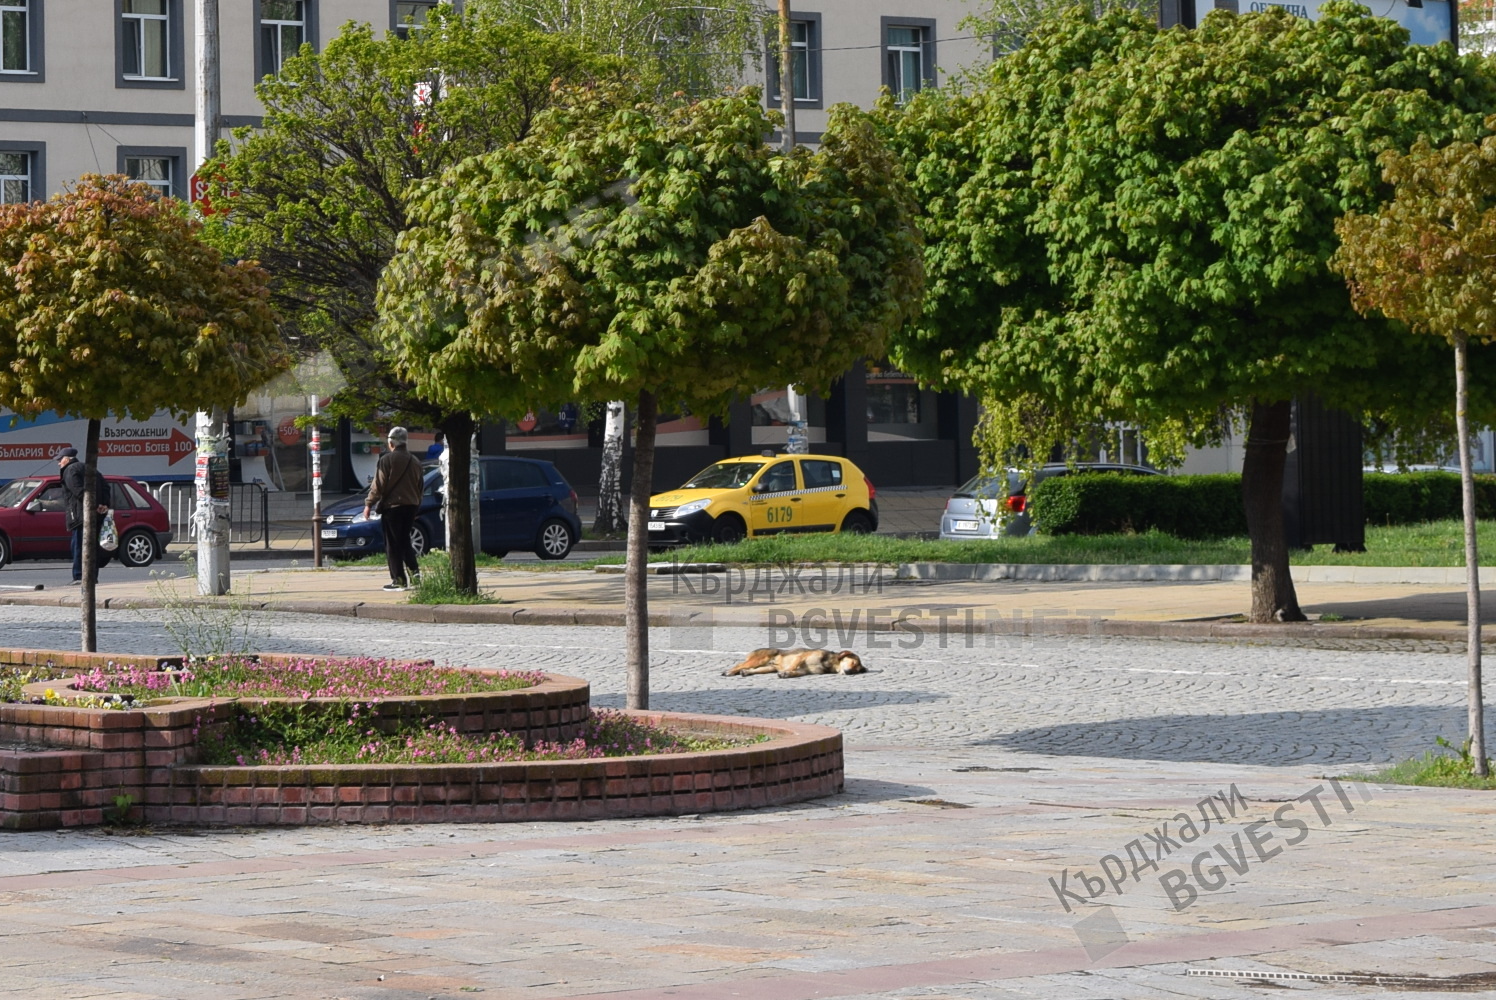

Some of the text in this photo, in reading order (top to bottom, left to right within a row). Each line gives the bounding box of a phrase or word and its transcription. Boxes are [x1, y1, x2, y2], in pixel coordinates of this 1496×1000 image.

[280, 427, 299, 436] -50%
[175, 440, 192, 452] 100
[767, 506, 792, 523] 6179
